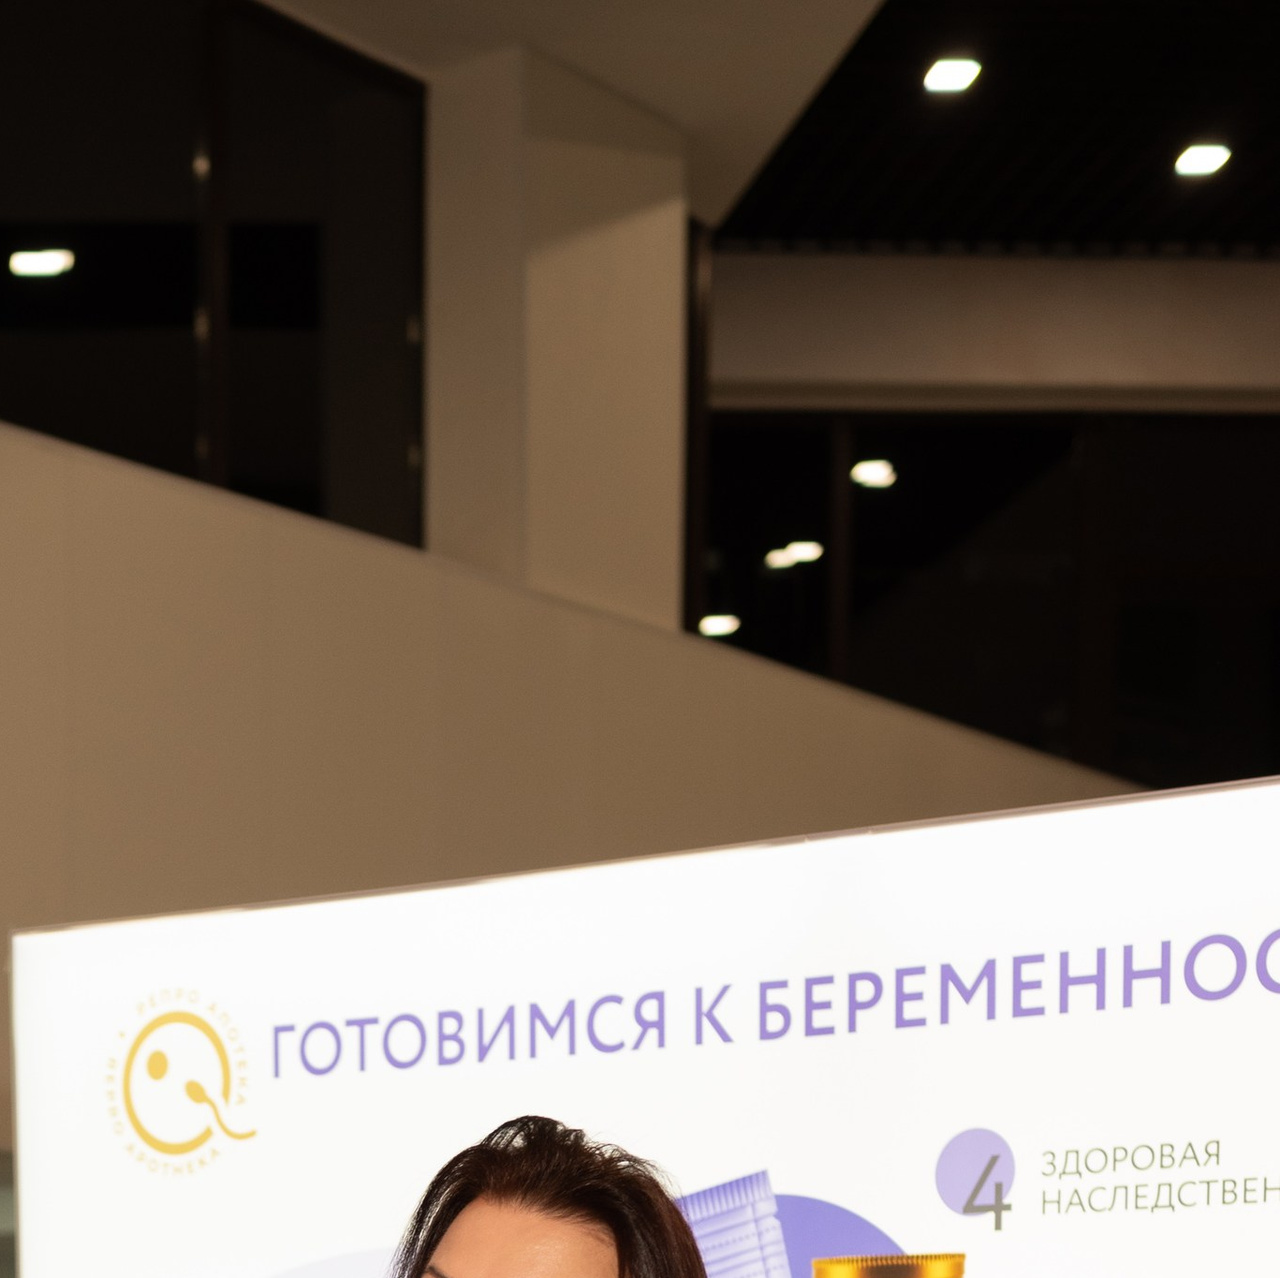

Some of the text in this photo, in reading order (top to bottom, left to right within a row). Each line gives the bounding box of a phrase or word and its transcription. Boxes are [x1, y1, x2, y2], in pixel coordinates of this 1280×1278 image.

[273, 991, 666, 1079] ГОТОВИМСЯ
[694, 984, 734, 1045] К
[962, 1153, 1013, 1232] 4
[1040, 1140, 1221, 1181] ЗДОРОВАЯ
